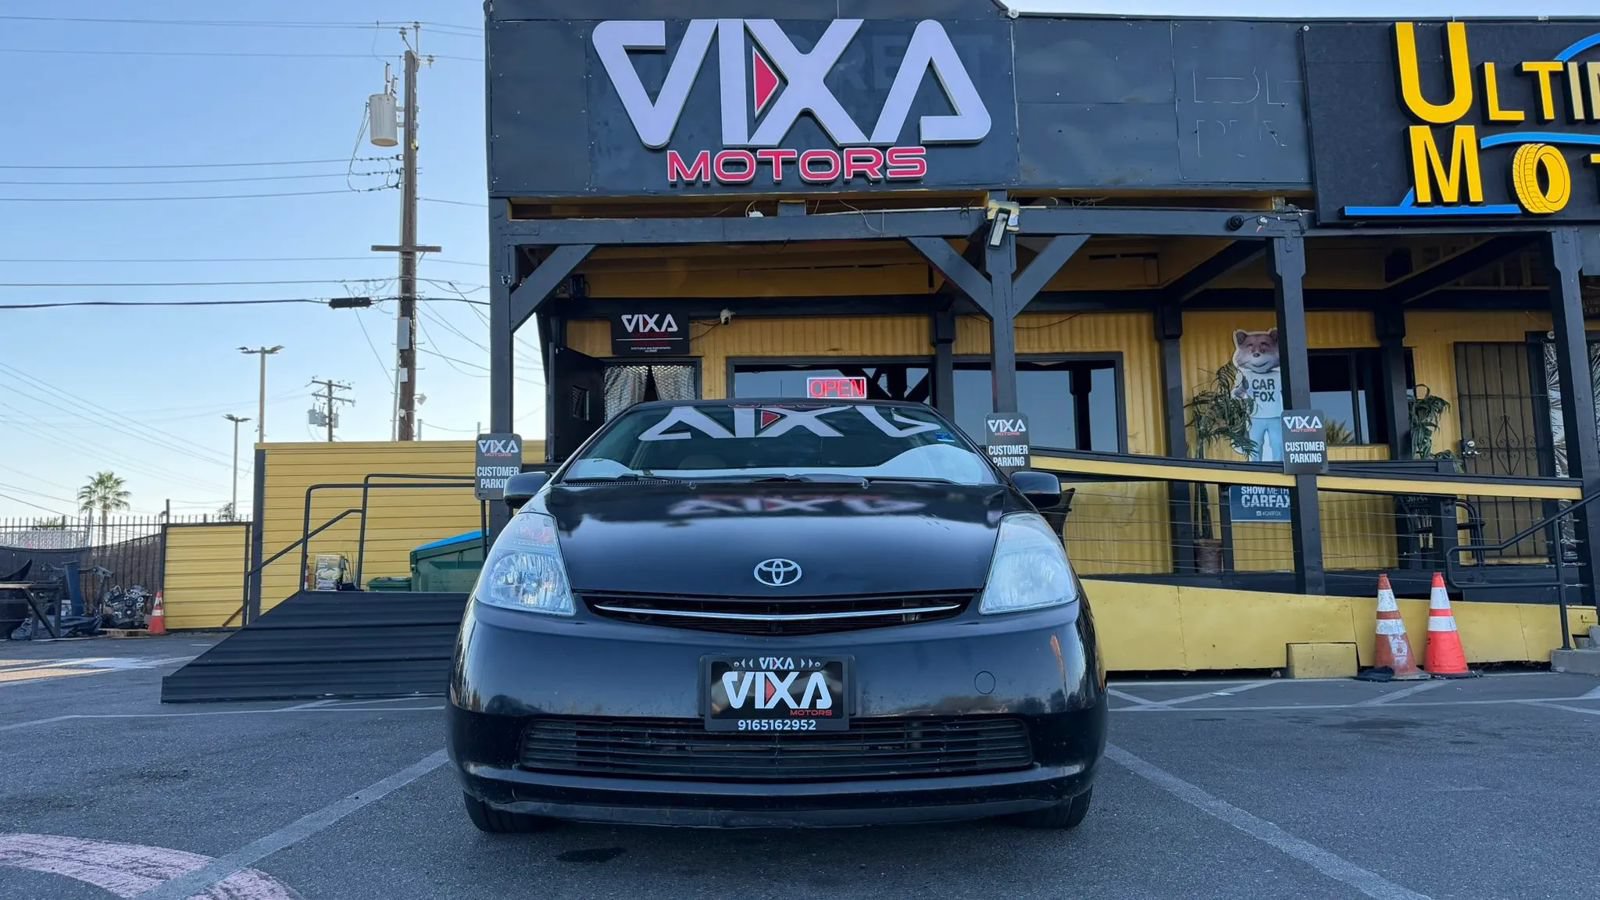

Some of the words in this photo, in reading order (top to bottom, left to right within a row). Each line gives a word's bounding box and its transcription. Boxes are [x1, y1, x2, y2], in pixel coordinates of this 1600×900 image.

[592, 18, 992, 150] VIXA
[666, 146, 927, 185] MOTORS
[1408, 124, 1600, 214] MO
[621, 313, 679, 333] VIXA
[810, 379, 864, 397] OPEN
[1252, 378, 1275, 390] CAR
[1253, 391, 1275, 402] FOX
[987, 419, 1026, 432] VIXA
[1283, 415, 1323, 429] VIXA
[477, 439, 519, 453] VIXA
[988, 445, 1028, 455] CUSTOMER
[1285, 441, 1325, 452] CUSTOMER
[993, 456, 1025, 466] PARKING
[1290, 452, 1322, 463] PARKING
[477, 466, 520, 477] CUSTOMER
[480, 478, 505, 489] PARKI
[1241, 485, 1265, 495] SHOW
[759, 657, 795, 670] VIXA
[722, 671, 832, 709] VIXA
[738, 720, 816, 731] 9165162952
